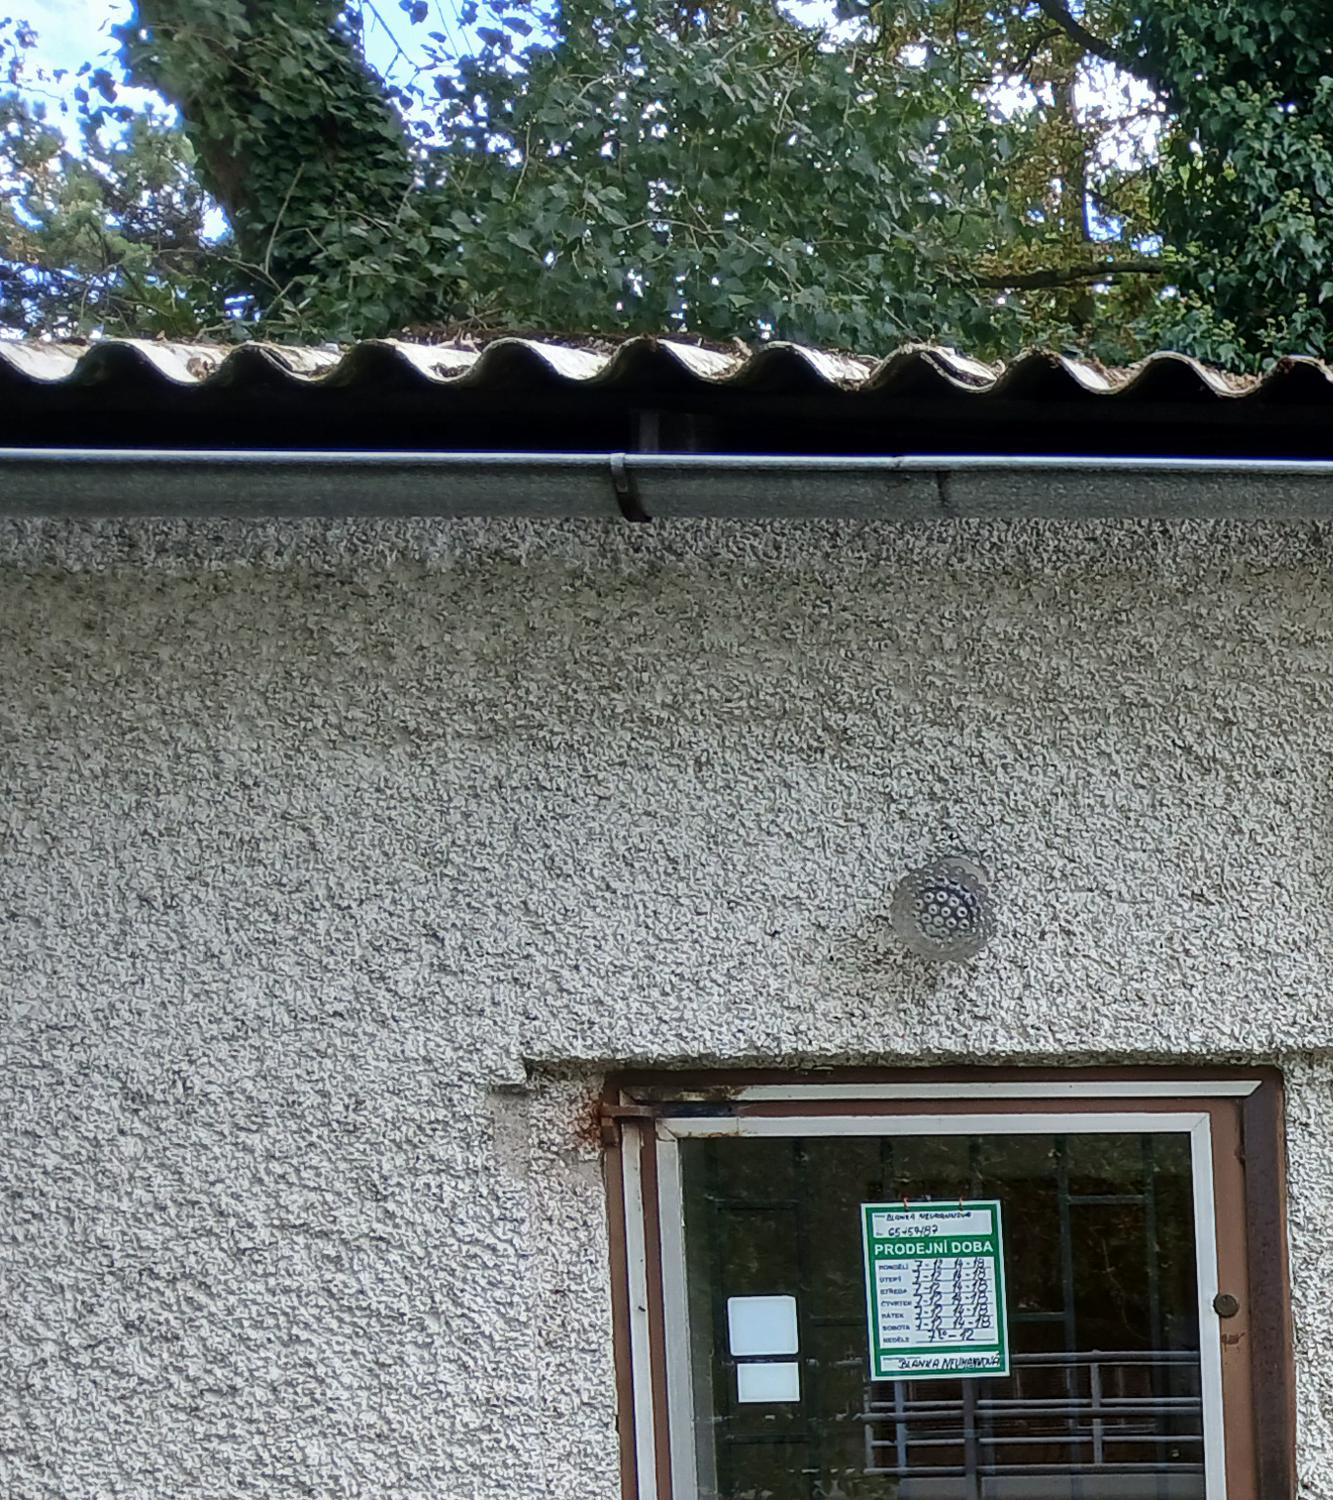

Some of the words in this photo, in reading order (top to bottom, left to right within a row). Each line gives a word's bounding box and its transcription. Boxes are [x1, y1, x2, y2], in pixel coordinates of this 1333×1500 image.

[874, 1240, 948, 1255] PRODEJNÍ
[951, 1240, 994, 1253] DOBA
[898, 1359, 939, 1370] BLANKA
